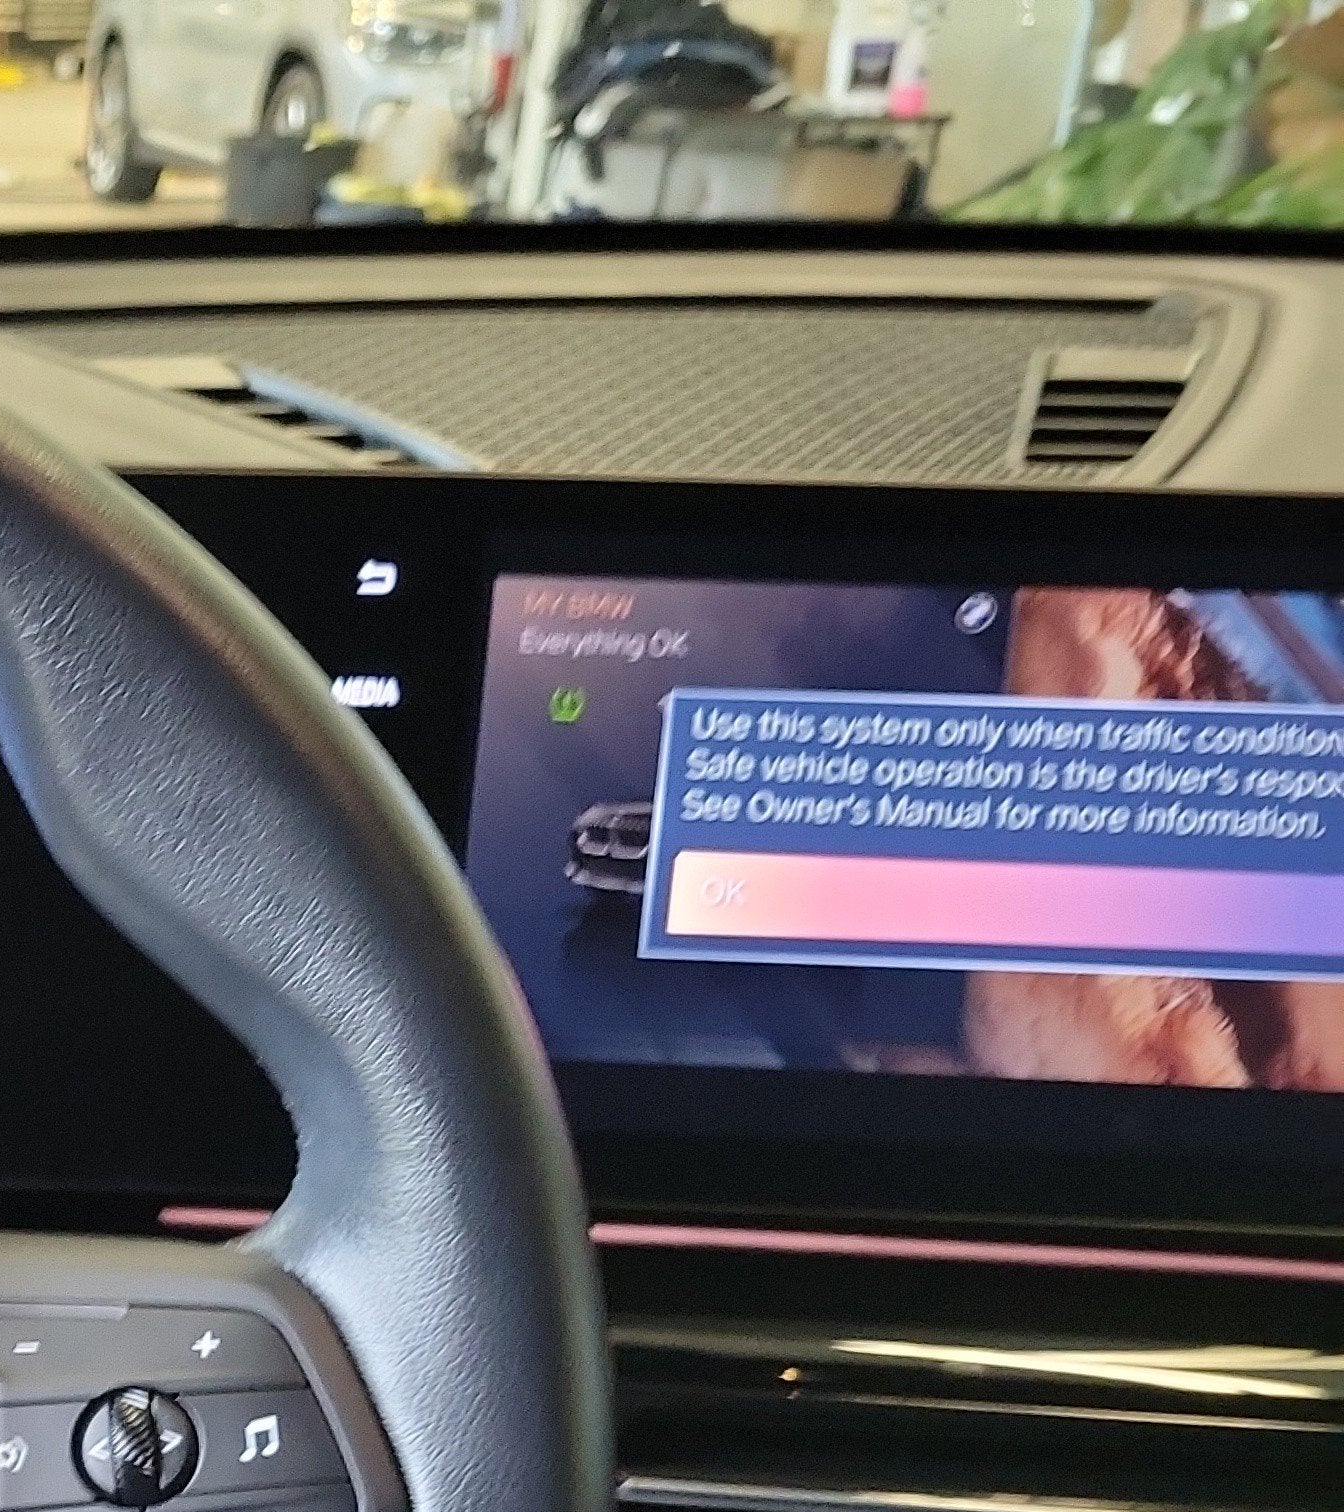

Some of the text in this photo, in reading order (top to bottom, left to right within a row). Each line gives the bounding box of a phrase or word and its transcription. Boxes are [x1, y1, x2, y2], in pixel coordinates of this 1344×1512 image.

[518, 626, 691, 663] Everything OK
[331, 674, 401, 708] MEDIA
[691, 707, 754, 741] Use
[757, 708, 816, 743] this
[819, 712, 932, 750] system
[934, 714, 1007, 753] only
[1008, 716, 1095, 750] when
[1098, 717, 1193, 754] traffic
[685, 747, 757, 783] Safe
[761, 750, 870, 785] vehicle
[872, 755, 1024, 793] operation
[1027, 757, 1059, 791] is
[1062, 757, 1118, 793] the
[1119, 760, 1240, 797] driver's
[680, 787, 1327, 840] See Owner's Manual for more information.
[700, 878, 747, 906] OK
